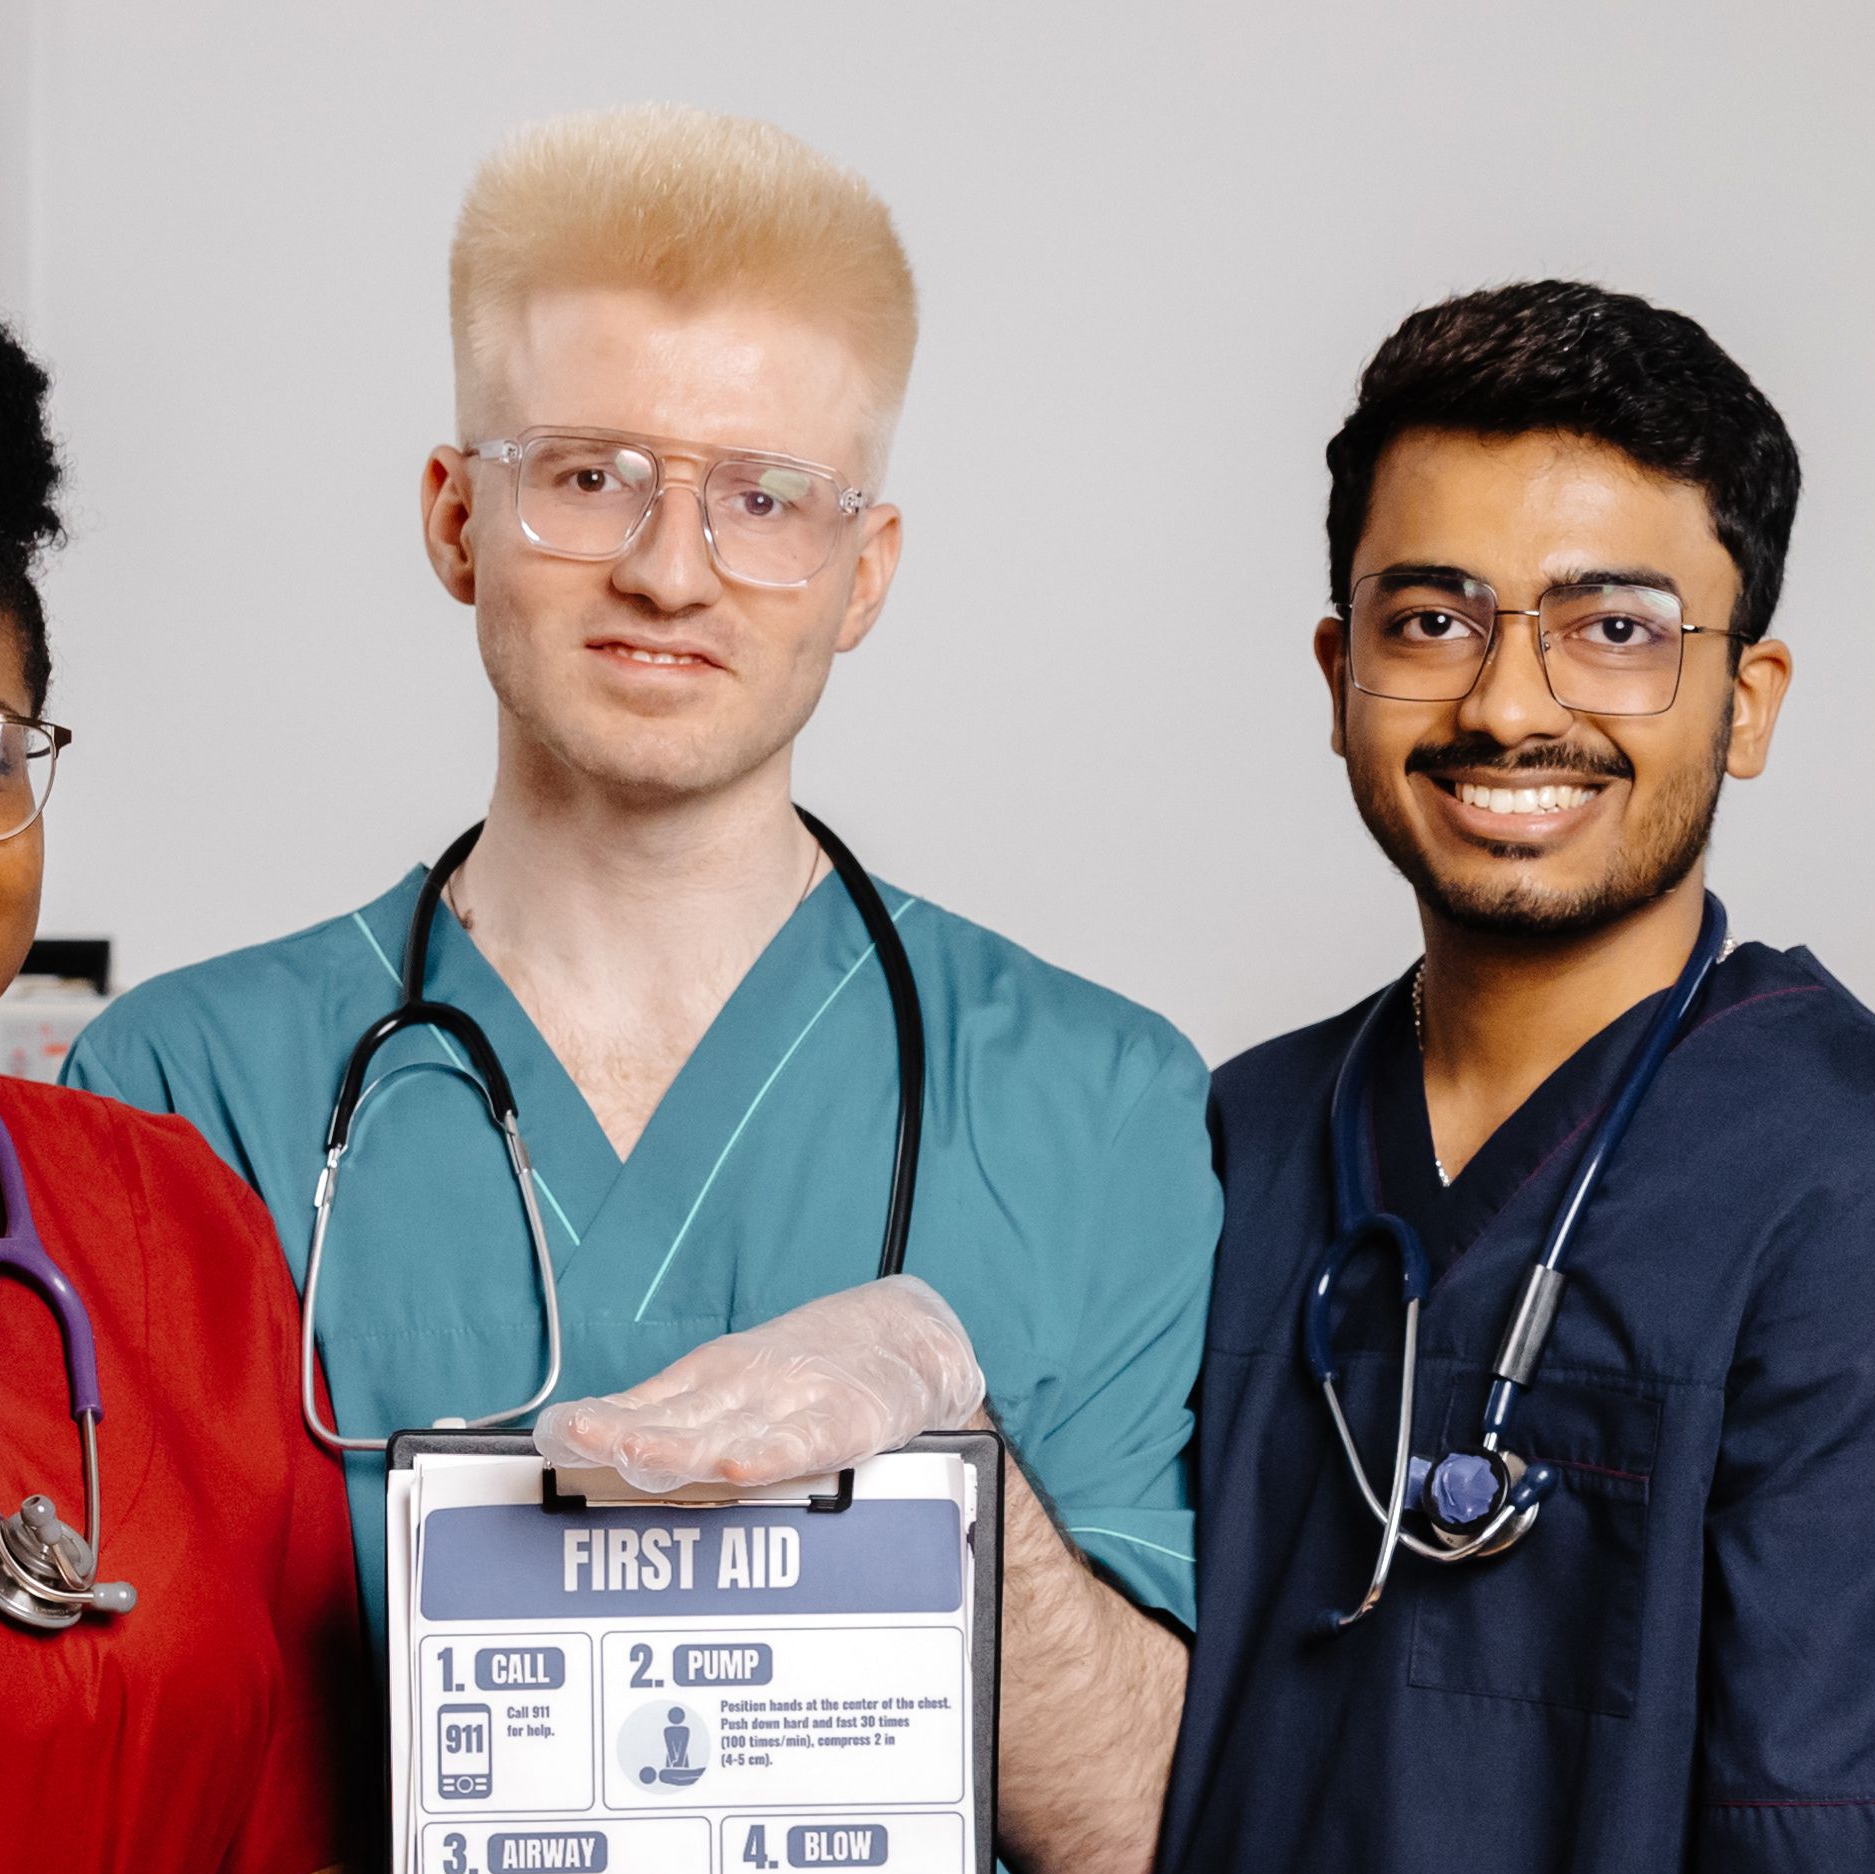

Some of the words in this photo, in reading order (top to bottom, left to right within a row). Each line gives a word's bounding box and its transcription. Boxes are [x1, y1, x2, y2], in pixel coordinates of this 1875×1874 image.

[563, 1528, 703, 1592] FIRST
[718, 1526, 800, 1588] AID
[438, 1647, 465, 1692] 1.
[492, 1653, 549, 1684] CALL
[629, 1643, 664, 1688] 2.
[688, 1649, 759, 1680] PUMP
[507, 1706, 528, 1718] Call
[533, 1706, 549, 1718] 911
[721, 1700, 766, 1712] Position
[770, 1699, 803, 1711] hands
[806, 1699, 817, 1711] at
[821, 1698, 839, 1711] the
[843, 1698, 879, 1711] center
[882, 1698, 895, 1710] of
[897, 1697, 914, 1710] the
[918, 1697, 951, 1710] chest.
[507, 1725, 523, 1737] for
[527, 1724, 554, 1738] help.
[721, 1718, 749, 1730] Push
[752, 1717, 780, 1730] down
[784, 1717, 808, 1729] hard
[812, 1717, 832, 1729] and
[836, 1716, 857, 1728] fast
[861, 1716, 875, 1727] 30
[878, 1715, 909, 1728] times
[446, 1724, 483, 1754] 911
[721, 1735, 746, 1749] (100
[749, 1734, 815, 1748] times/min),
[817, 1734, 870, 1748] compress
[874, 1734, 881, 1745] 2
[885, 1733, 895, 1745] in
[721, 1753, 745, 1767] (4-5
[749, 1753, 772, 1766] cm).
[502, 1838, 595, 1870] AIRWAY
[743, 1825, 778, 1869] 4.
[804, 1831, 872, 1861] BLOW
